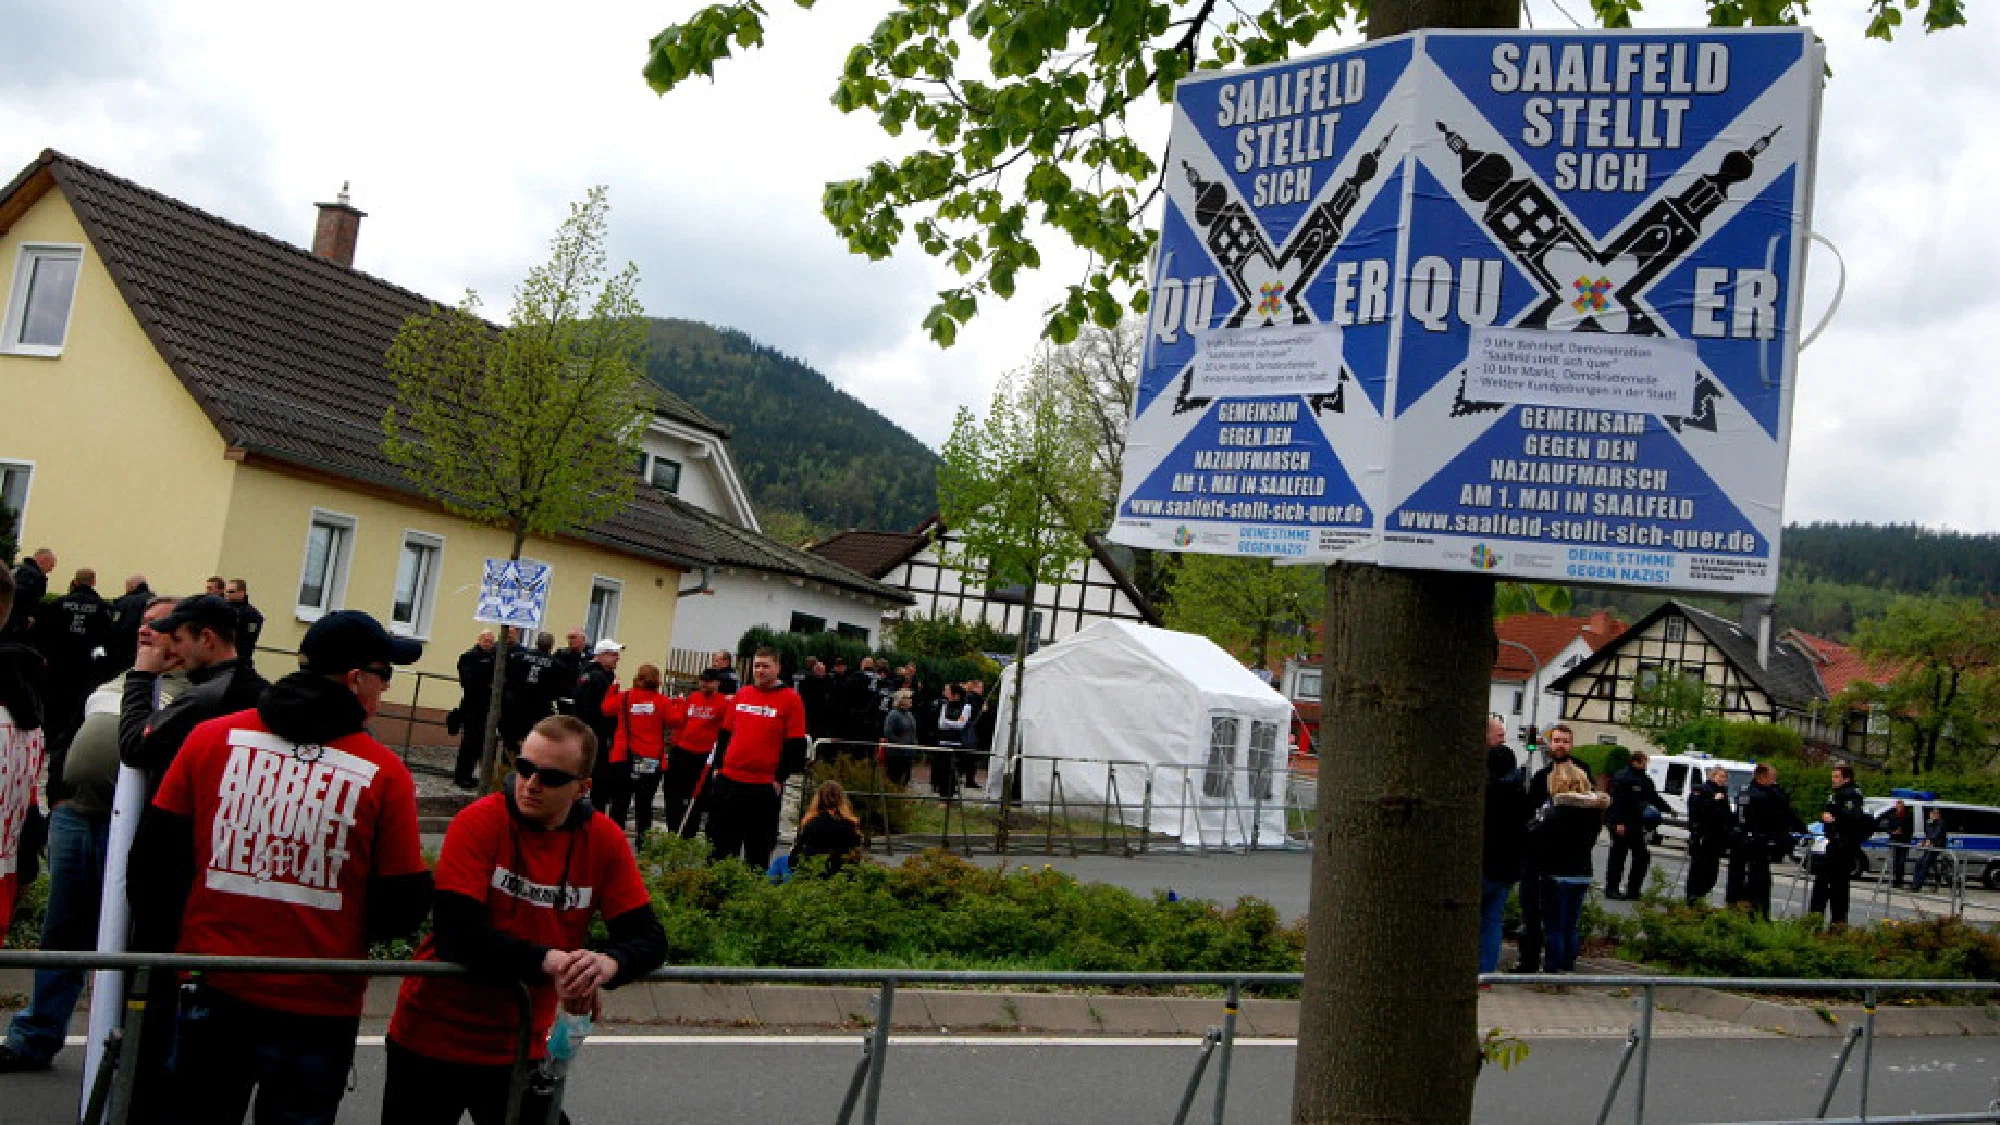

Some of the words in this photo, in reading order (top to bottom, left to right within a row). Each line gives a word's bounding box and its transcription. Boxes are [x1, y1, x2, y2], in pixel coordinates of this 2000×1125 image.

[1490, 42, 1730, 94] SAALFELD
[1218, 58, 1366, 127] SAALFELD
[1522, 98, 1692, 149] STELLT
[1236, 113, 1341, 173] STELLT
[1254, 167, 1313, 208] SICH
[1555, 152, 1648, 191] SICH
[1409, 255, 1503, 331] QU
[1692, 267, 1781, 340] ER
[1494, 338, 1515, 348] Uhr
[1568, 342, 1653, 358] Demonstration
[1483, 362, 1496, 375] 10
[1498, 364, 1520, 375] Uhr
[1218, 427, 1263, 446] GEGEN
[1265, 427, 1292, 446] DEN
[1520, 407, 1646, 434] GEMEINSAM
[1525, 434, 1591, 459] GEGEN
[1595, 438, 1638, 461] DEN
[1172, 472, 1196, 492] AM
[1211, 474, 1237, 494] MAI
[1239, 475, 1257, 494] IN
[1259, 476, 1326, 496] SAALFELD
[1490, 459, 1668, 491] NAZIAUFMARSCH
[1459, 484, 1493, 508] AM
[1498, 487, 1514, 510] 1.
[1518, 488, 1559, 511] MAI
[1564, 490, 1588, 514] IN
[1593, 492, 1694, 520] SAALFELD
[1398, 509, 1756, 553] www.saalfeld-stellt-sich-quer.de
[1566, 564, 1616, 579] GEGEN
[1620, 568, 1670, 583] NAZIS!
[1568, 548, 1613, 563] DEINE
[1617, 551, 1675, 568] STIMME
[219, 744, 371, 826] ARBEIT
